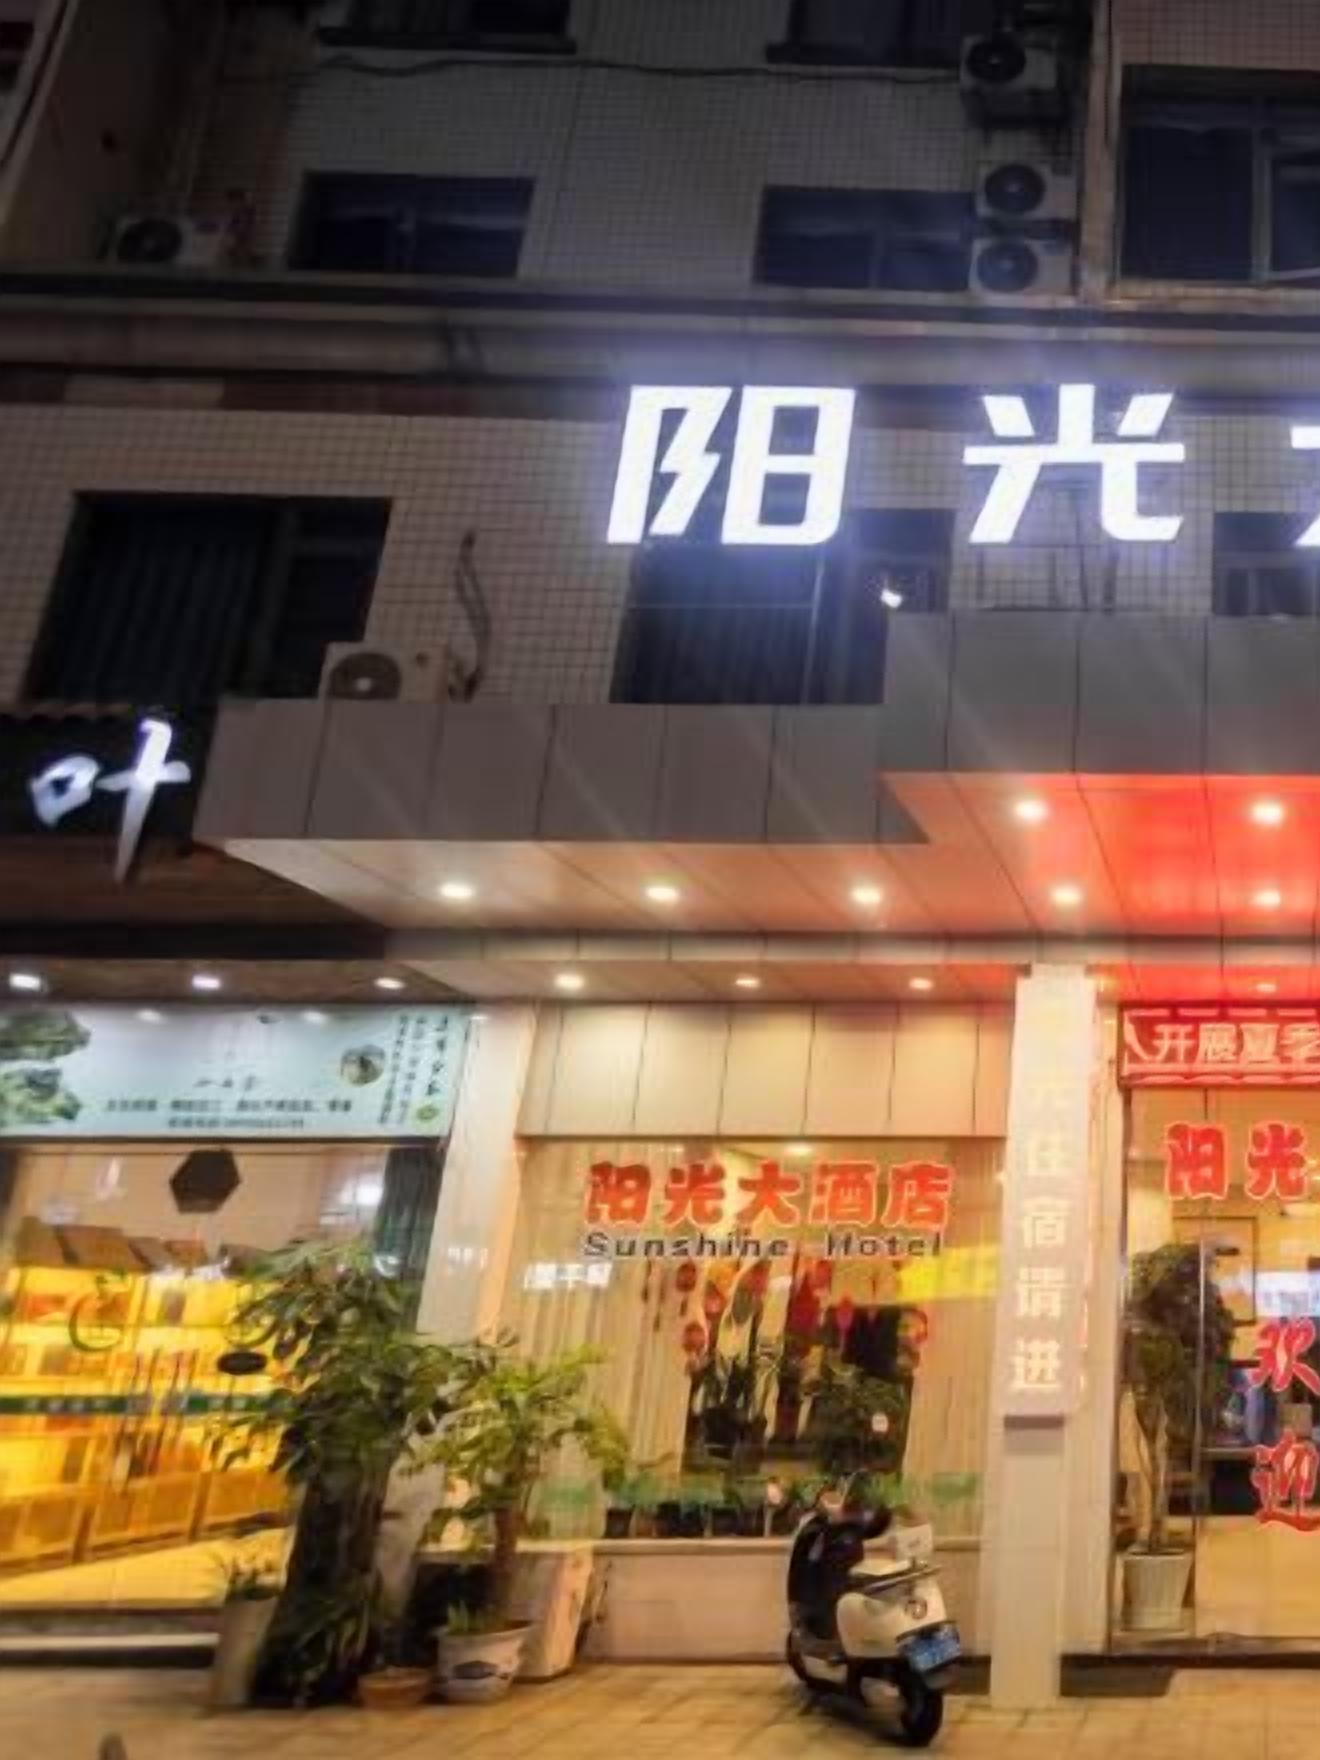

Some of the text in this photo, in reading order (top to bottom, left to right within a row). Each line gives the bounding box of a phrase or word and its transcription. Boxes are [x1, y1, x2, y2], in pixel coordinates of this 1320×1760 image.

[584, 1159, 956, 1229] 阳光大酒店
[583, 1231, 943, 1259] Sunshine Hotel
